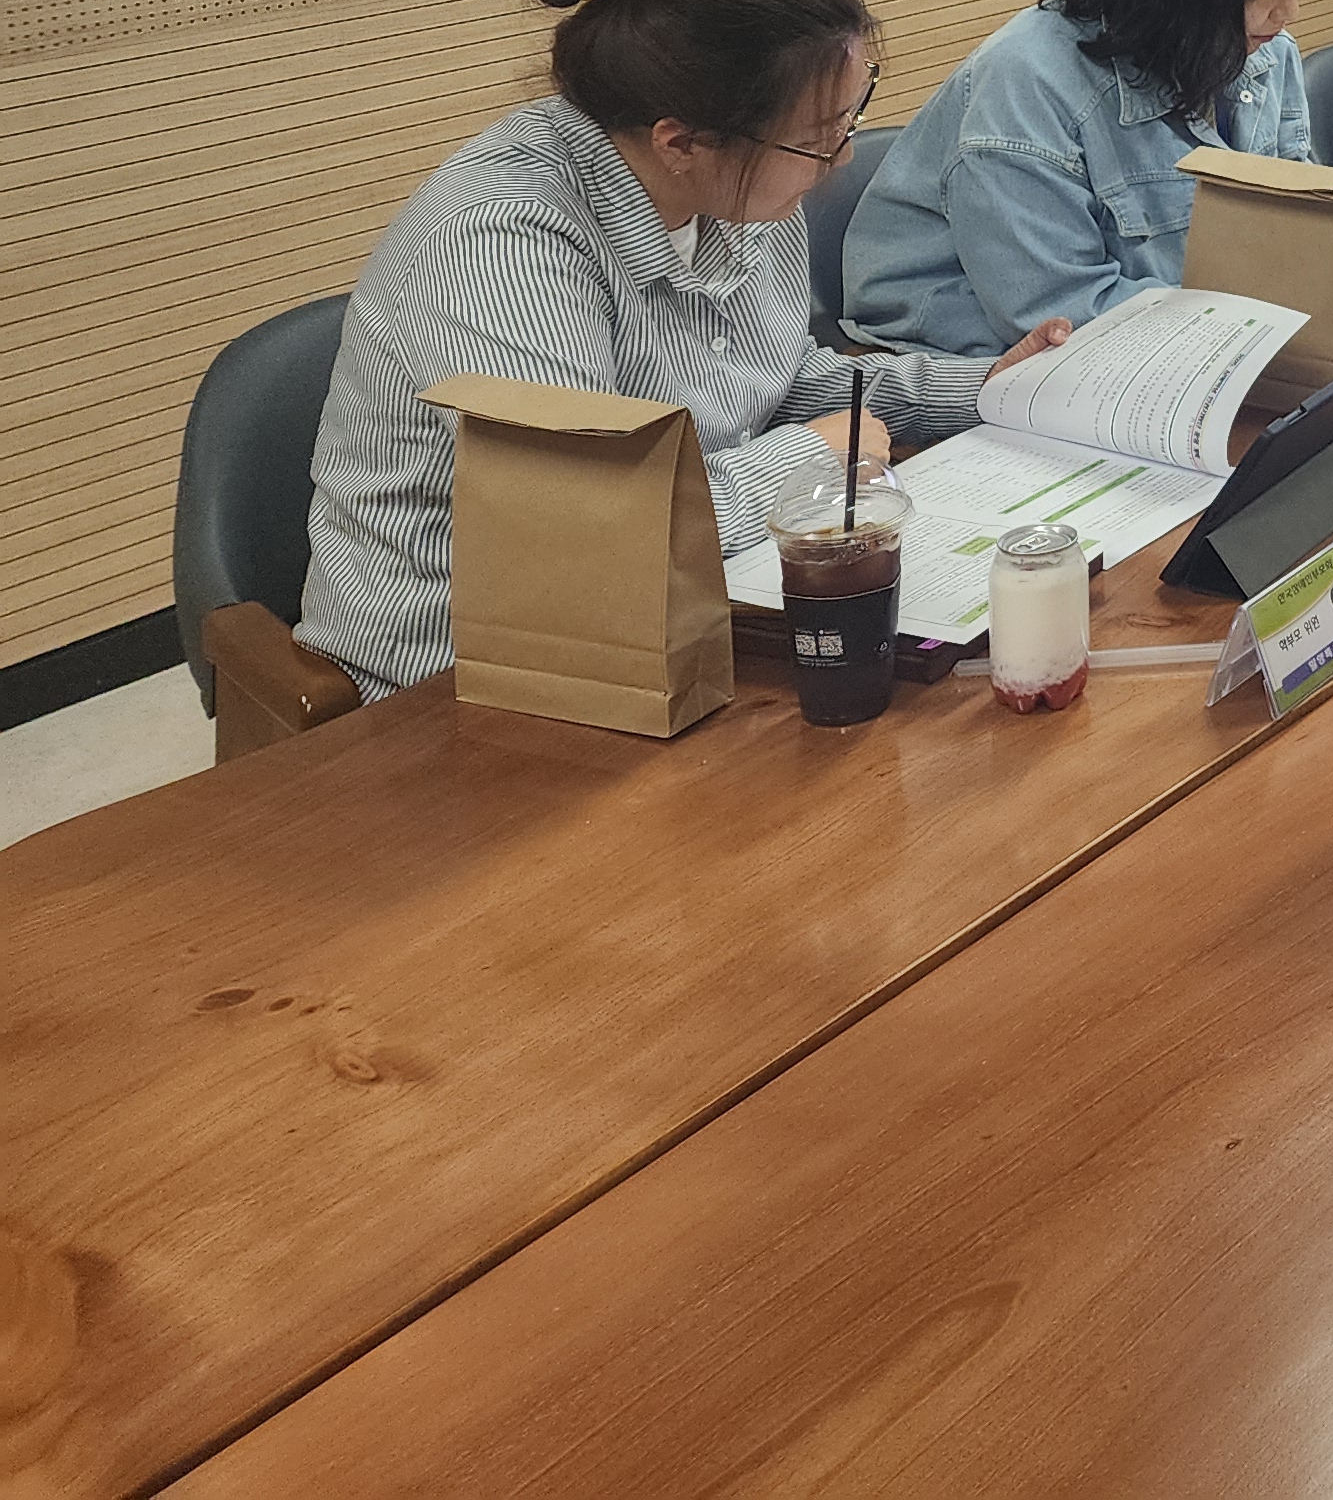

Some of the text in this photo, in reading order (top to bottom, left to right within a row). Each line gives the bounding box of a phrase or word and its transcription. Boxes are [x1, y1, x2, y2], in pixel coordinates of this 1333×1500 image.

[1277, 561, 1333, 605] 한국장애인부모회
[1278, 629, 1302, 652] 학부모
[1303, 615, 1321, 635] 위원
